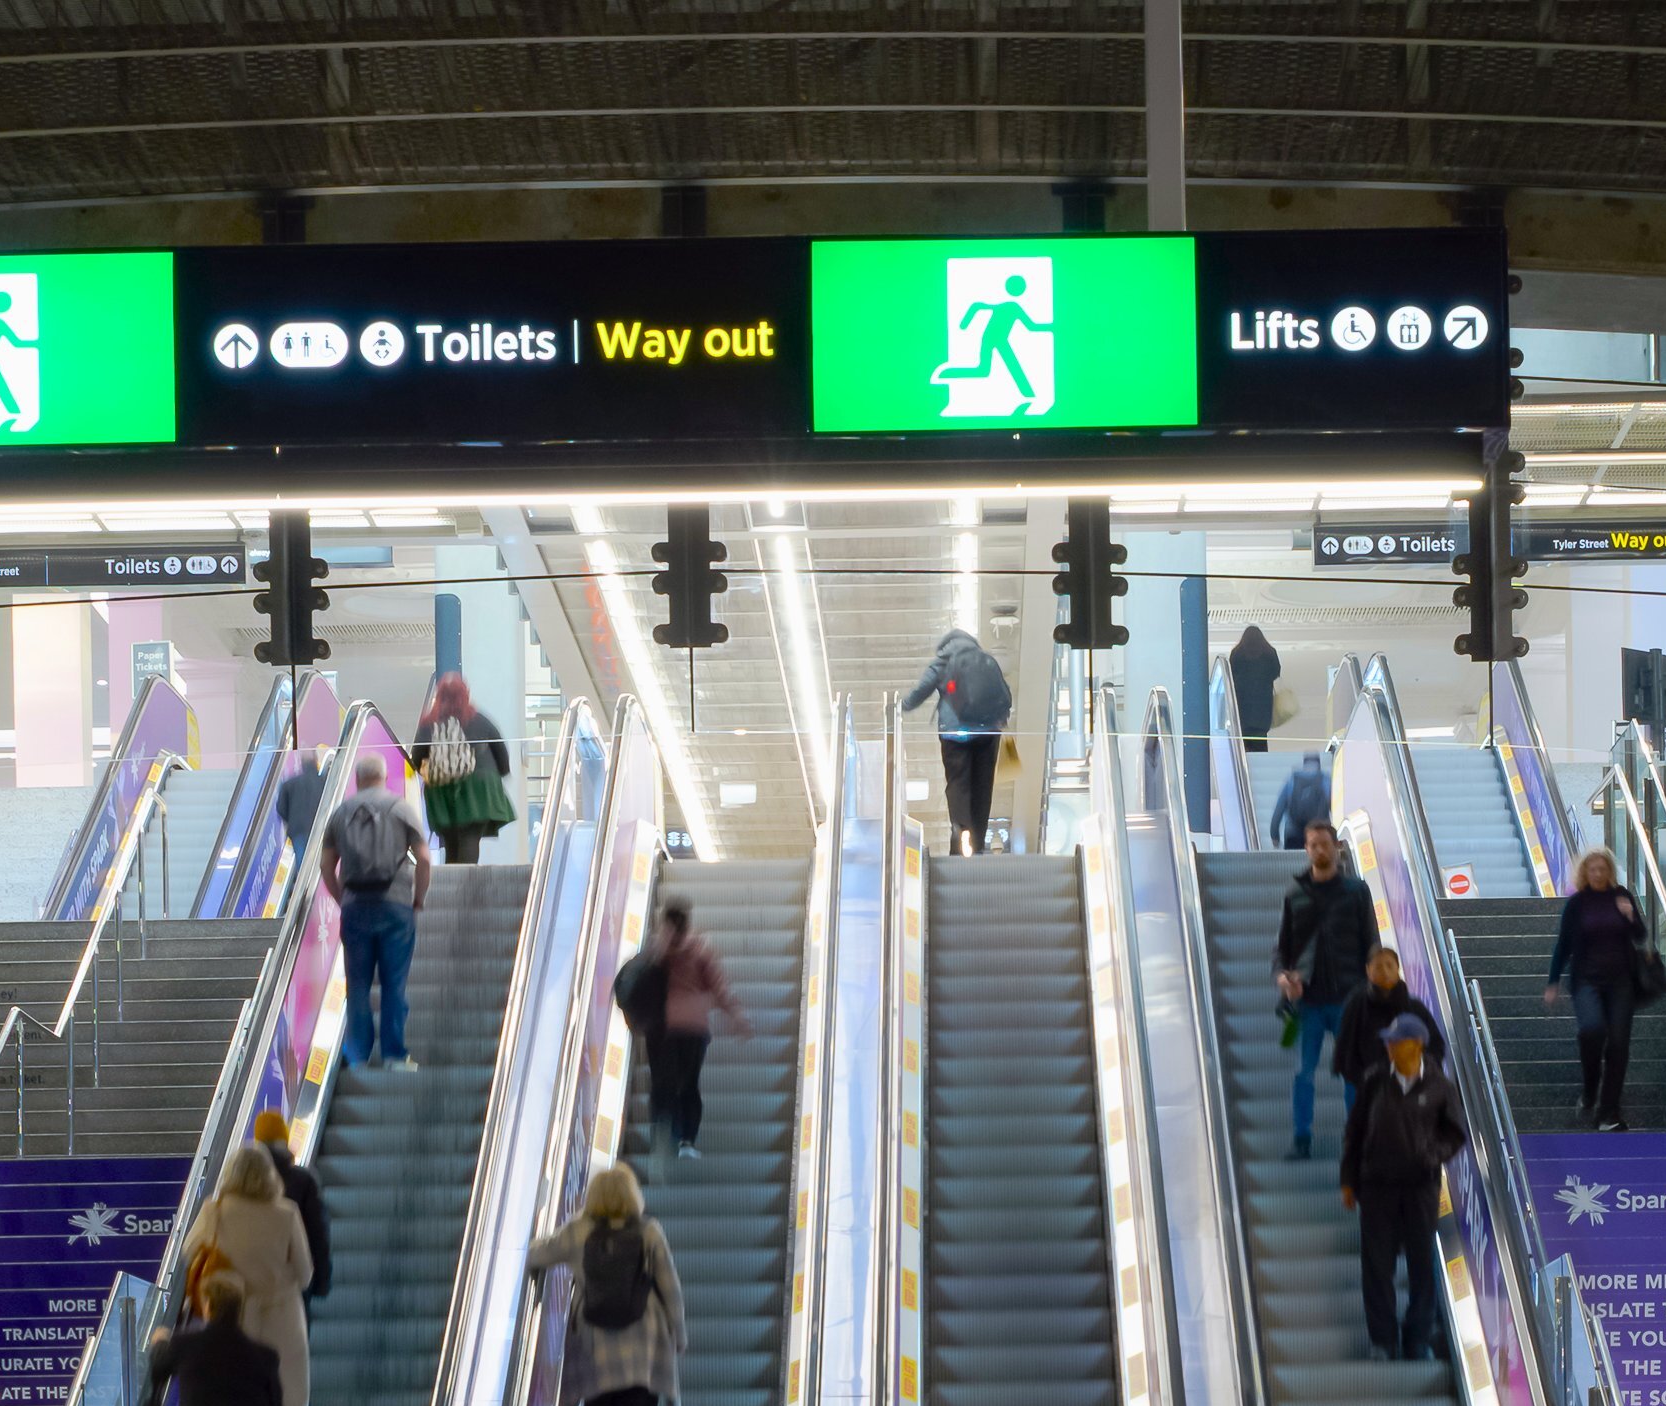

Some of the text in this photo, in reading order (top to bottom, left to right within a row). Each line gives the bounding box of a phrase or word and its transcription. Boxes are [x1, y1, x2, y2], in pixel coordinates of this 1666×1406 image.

[1229, 310, 1319, 353] Lifts
[416, 322, 557, 362] Toilets
[596, 321, 774, 365] Way out
[1399, 535, 1456, 553] Toilets
[1552, 538, 1578, 552] Tyler
[1579, 537, 1609, 549] Street
[1610, 531, 1651, 551] Way
[104, 558, 160, 575] Toilets
[137, 651, 165, 661] Paper
[135, 662, 168, 672] Tickets
[1579, 1273, 1638, 1290] MORE
[48, 1299, 97, 1313] MORE
[2, 1327, 95, 1341] TRANSLATE
[1621, 1359, 1662, 1376] THE
[35, 1386, 69, 1400] THE
